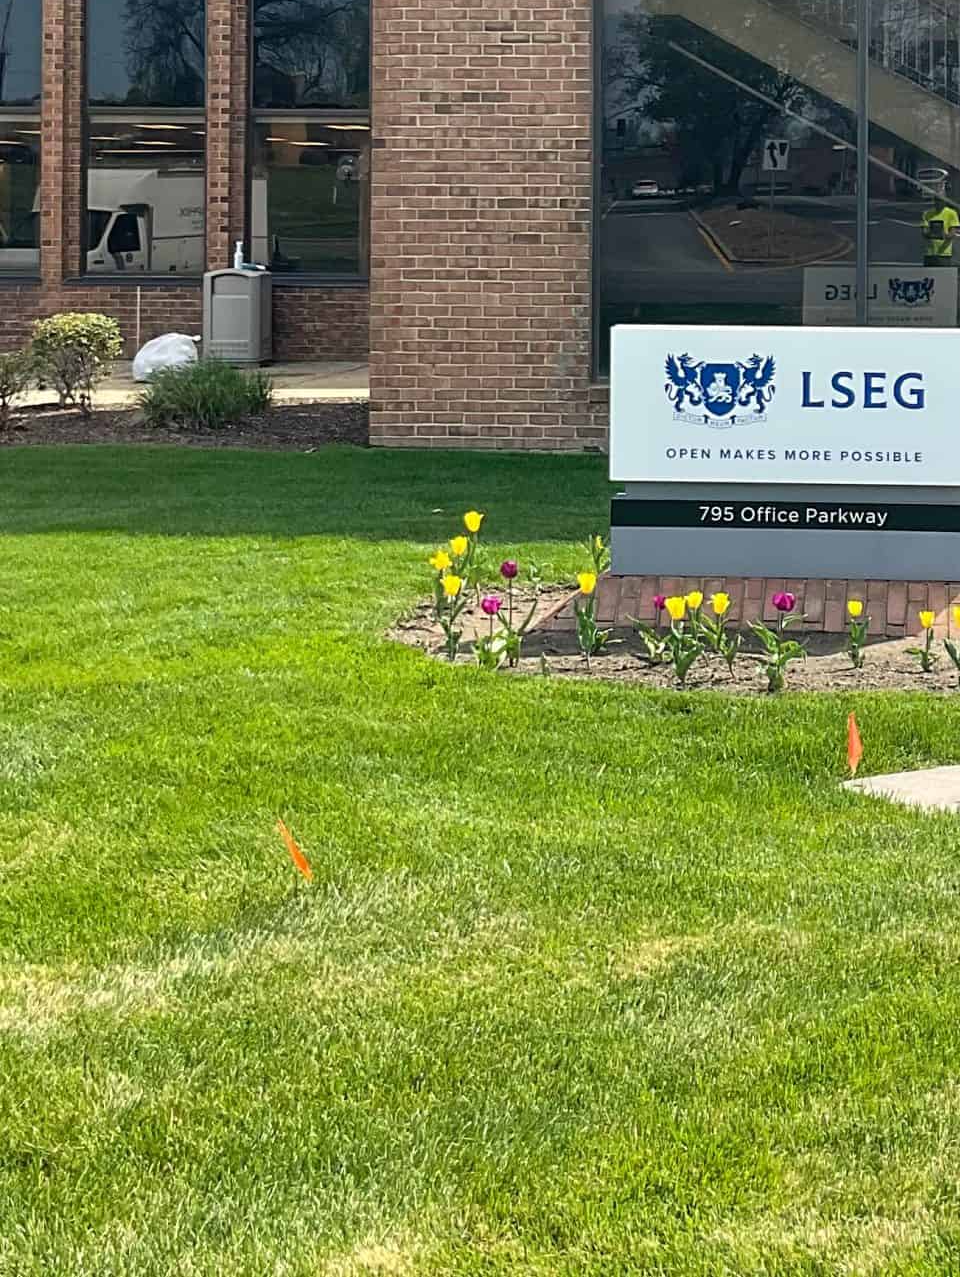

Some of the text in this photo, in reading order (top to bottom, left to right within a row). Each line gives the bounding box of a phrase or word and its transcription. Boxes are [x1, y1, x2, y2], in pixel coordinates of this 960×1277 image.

[801, 371, 925, 410] LSEG
[665, 447, 922, 463] OPEN MAKES MORE POSSIBLE
[698, 506, 888, 527] 795 Office Parkway
